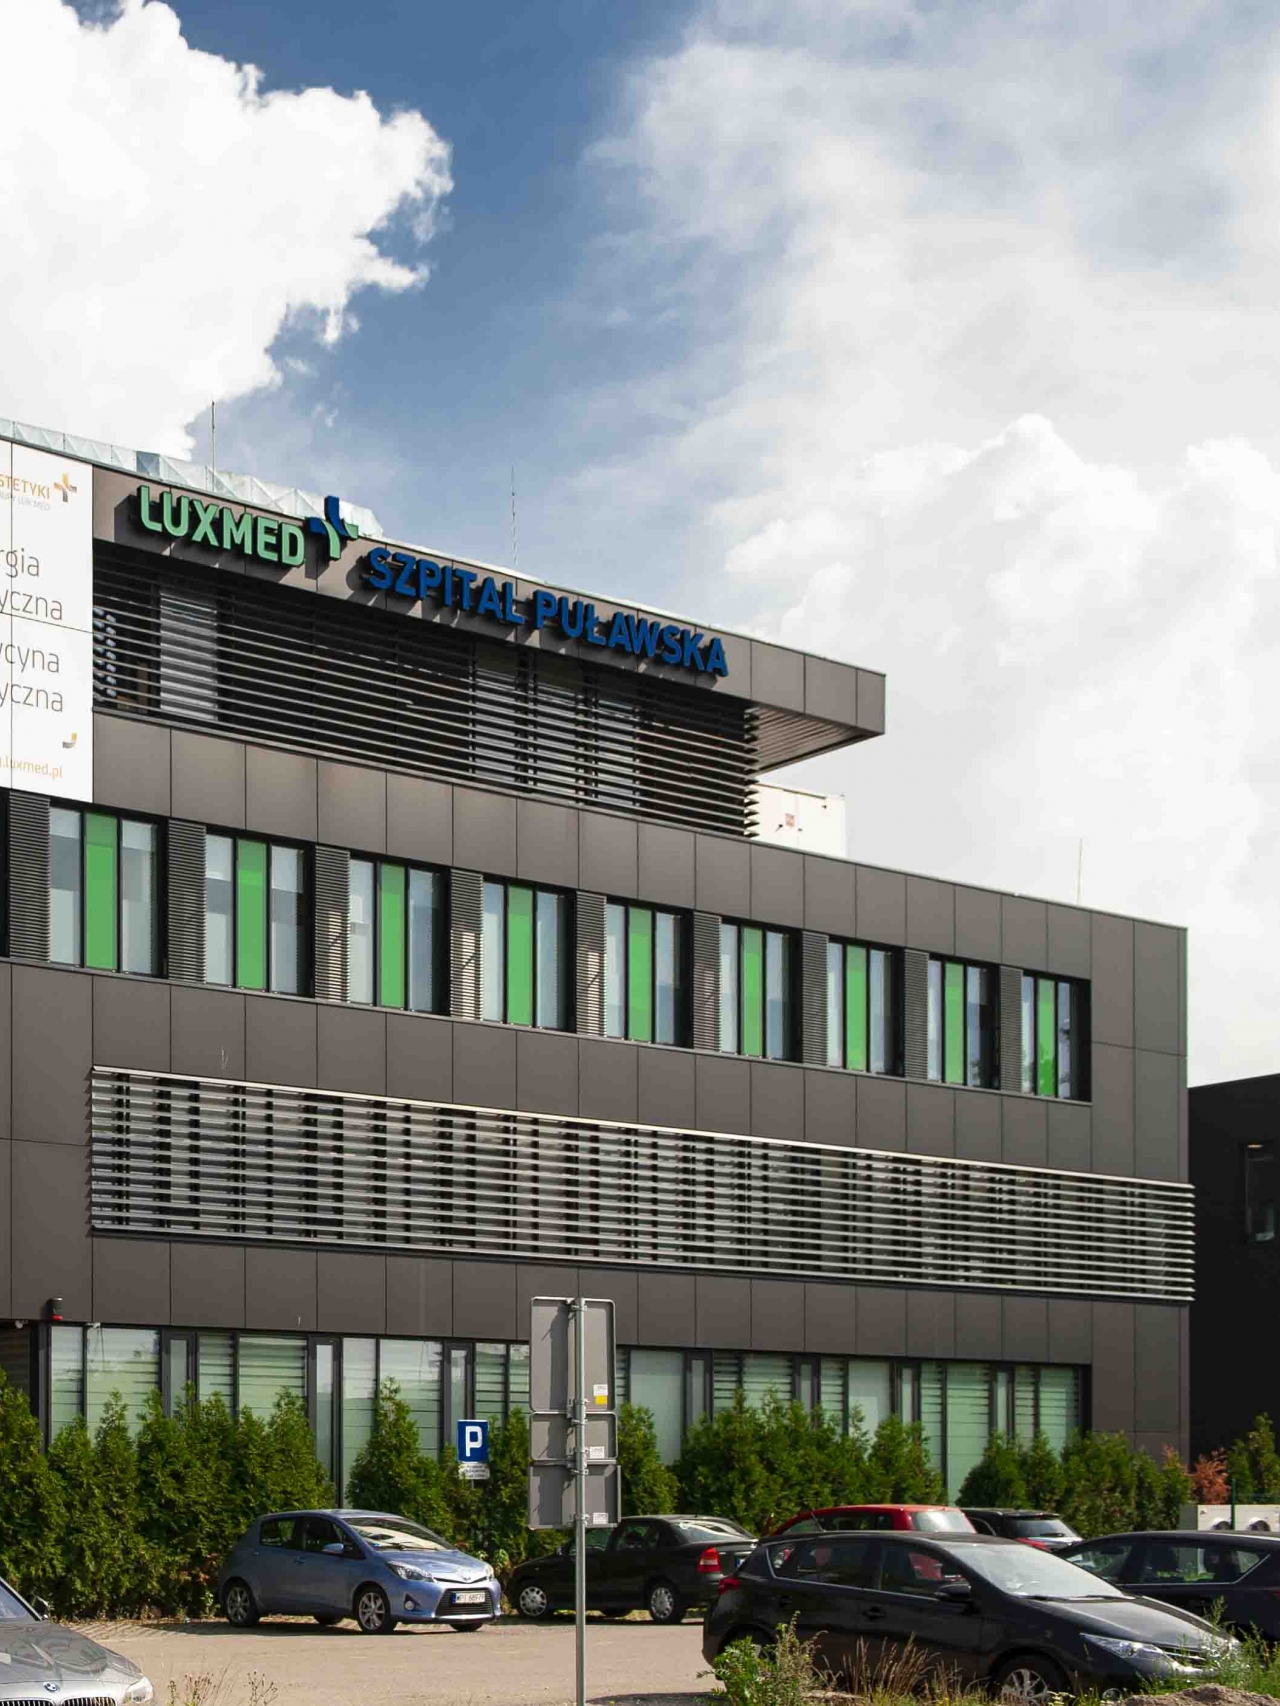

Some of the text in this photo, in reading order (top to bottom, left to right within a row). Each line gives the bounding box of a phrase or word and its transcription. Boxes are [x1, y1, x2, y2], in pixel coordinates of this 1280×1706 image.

[137, 485, 306, 567] LUXMED
[368, 547, 729, 678] SZPITAL PUŁAWSKA
[465, 1425, 483, 1458] P
